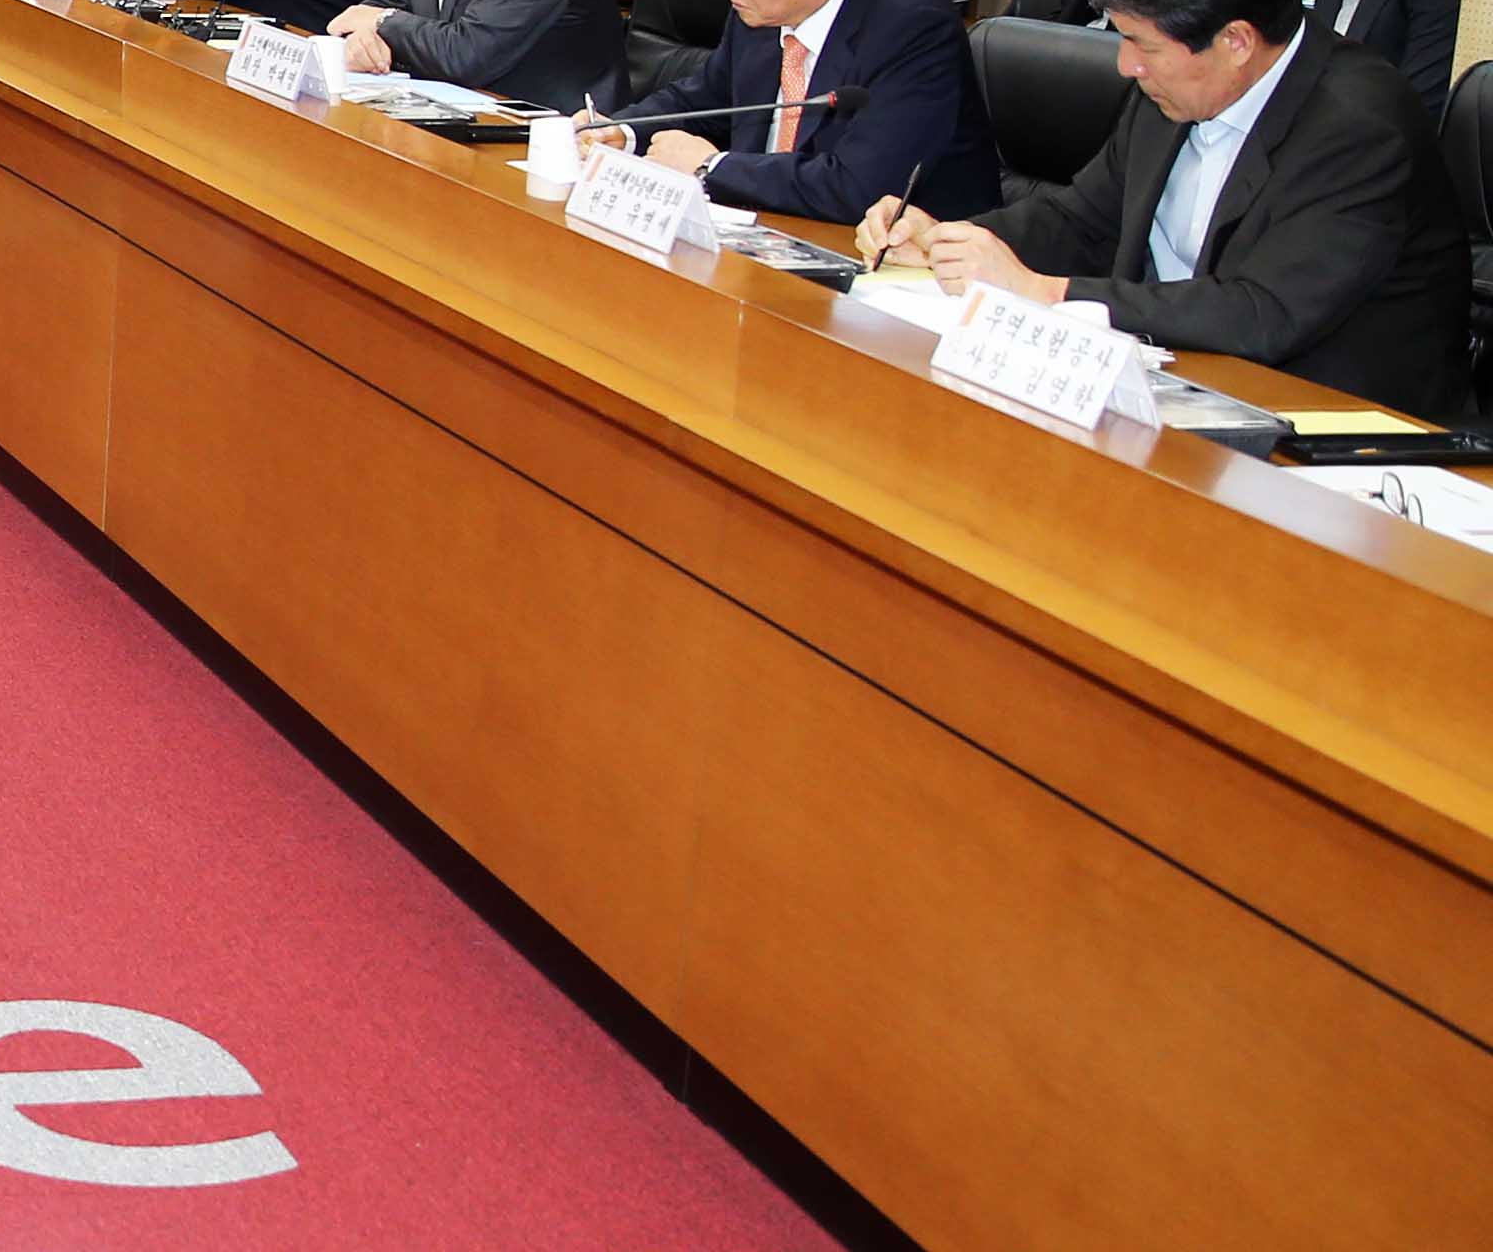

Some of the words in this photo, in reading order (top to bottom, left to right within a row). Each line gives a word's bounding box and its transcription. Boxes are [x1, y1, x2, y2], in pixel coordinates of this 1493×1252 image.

[985, 304, 1114, 372] 무역보험공사
[965, 340, 1009, 380] 사장
[1026, 365, 1094, 413] 김영학
